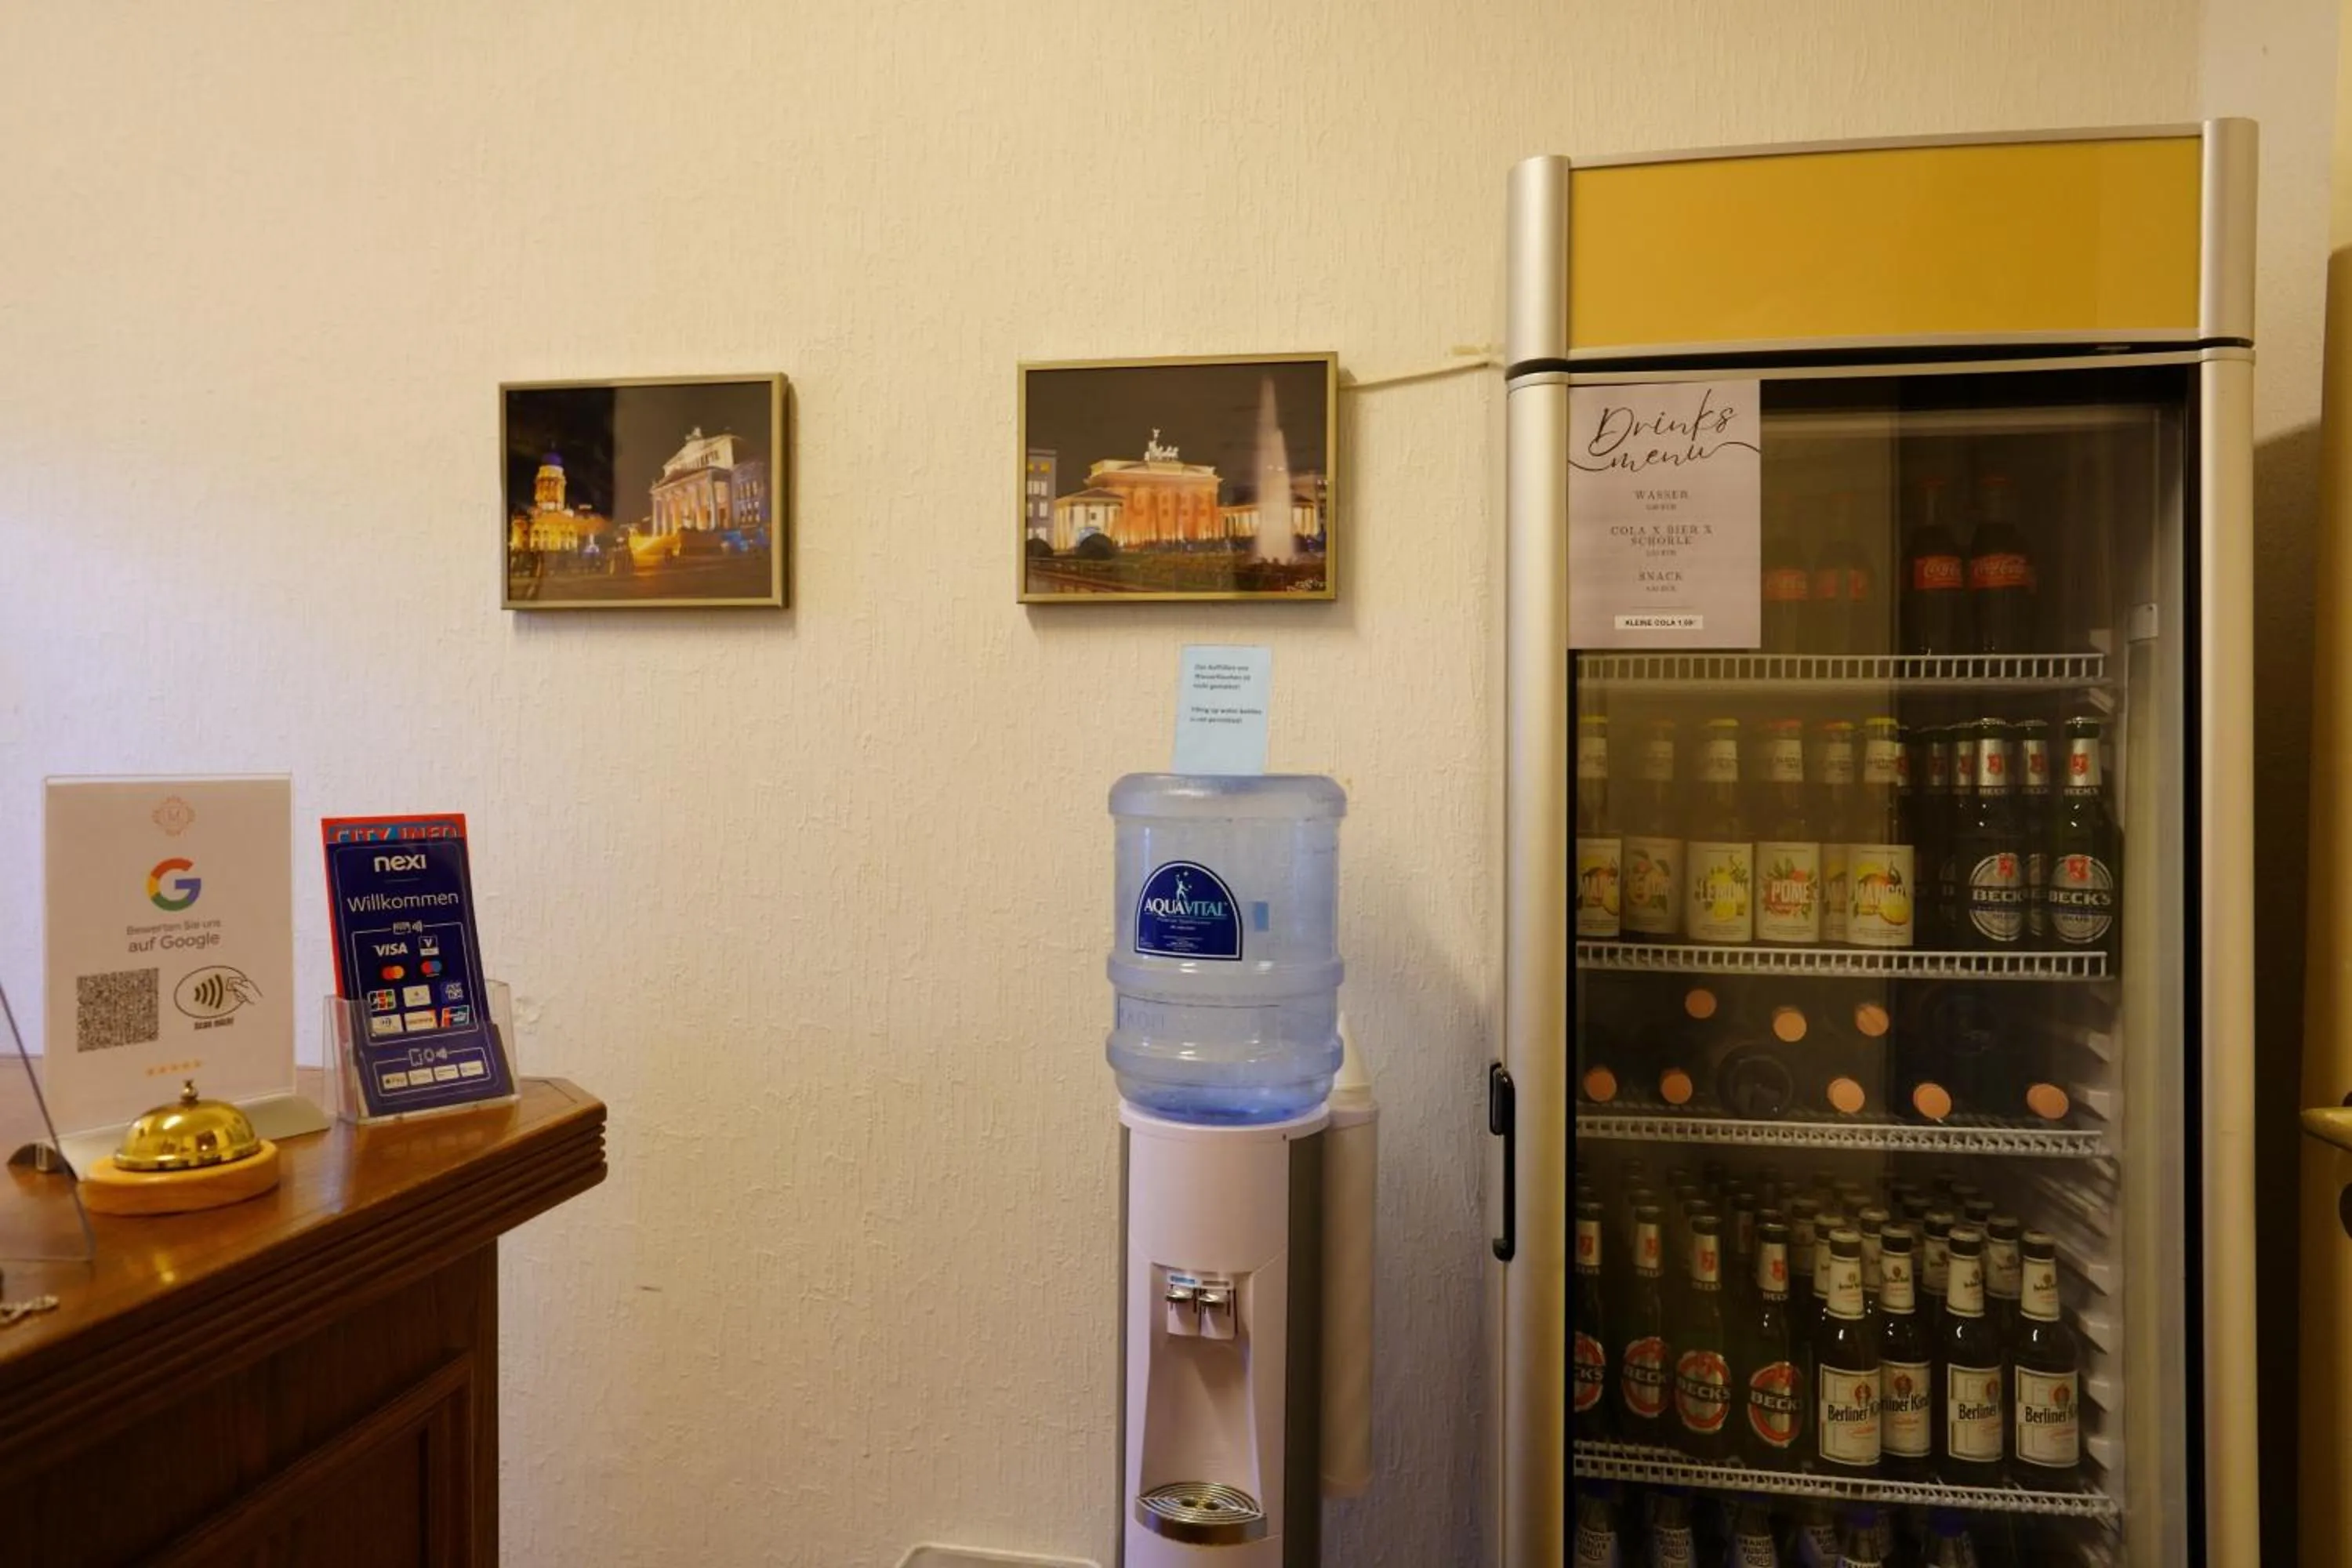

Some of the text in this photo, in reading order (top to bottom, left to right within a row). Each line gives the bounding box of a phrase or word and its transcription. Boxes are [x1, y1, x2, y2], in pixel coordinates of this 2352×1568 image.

[1588, 389, 1737, 456] Drinks
[1633, 490, 1689, 500] WASSER
[1610, 526, 1646, 535] COLA
[1667, 524, 1699, 535] BIER
[1638, 572, 1683, 581] SNACK
[373, 854, 426, 873] nexi
[347, 891, 459, 913] Willkommen
[1144, 898, 1228, 916] AQUAVITAL
[128, 931, 221, 953] auf Google
[372, 942, 408, 957] VISA
[1828, 1404, 1869, 1422] Berliner
[2025, 1406, 2067, 1424] Berliner
